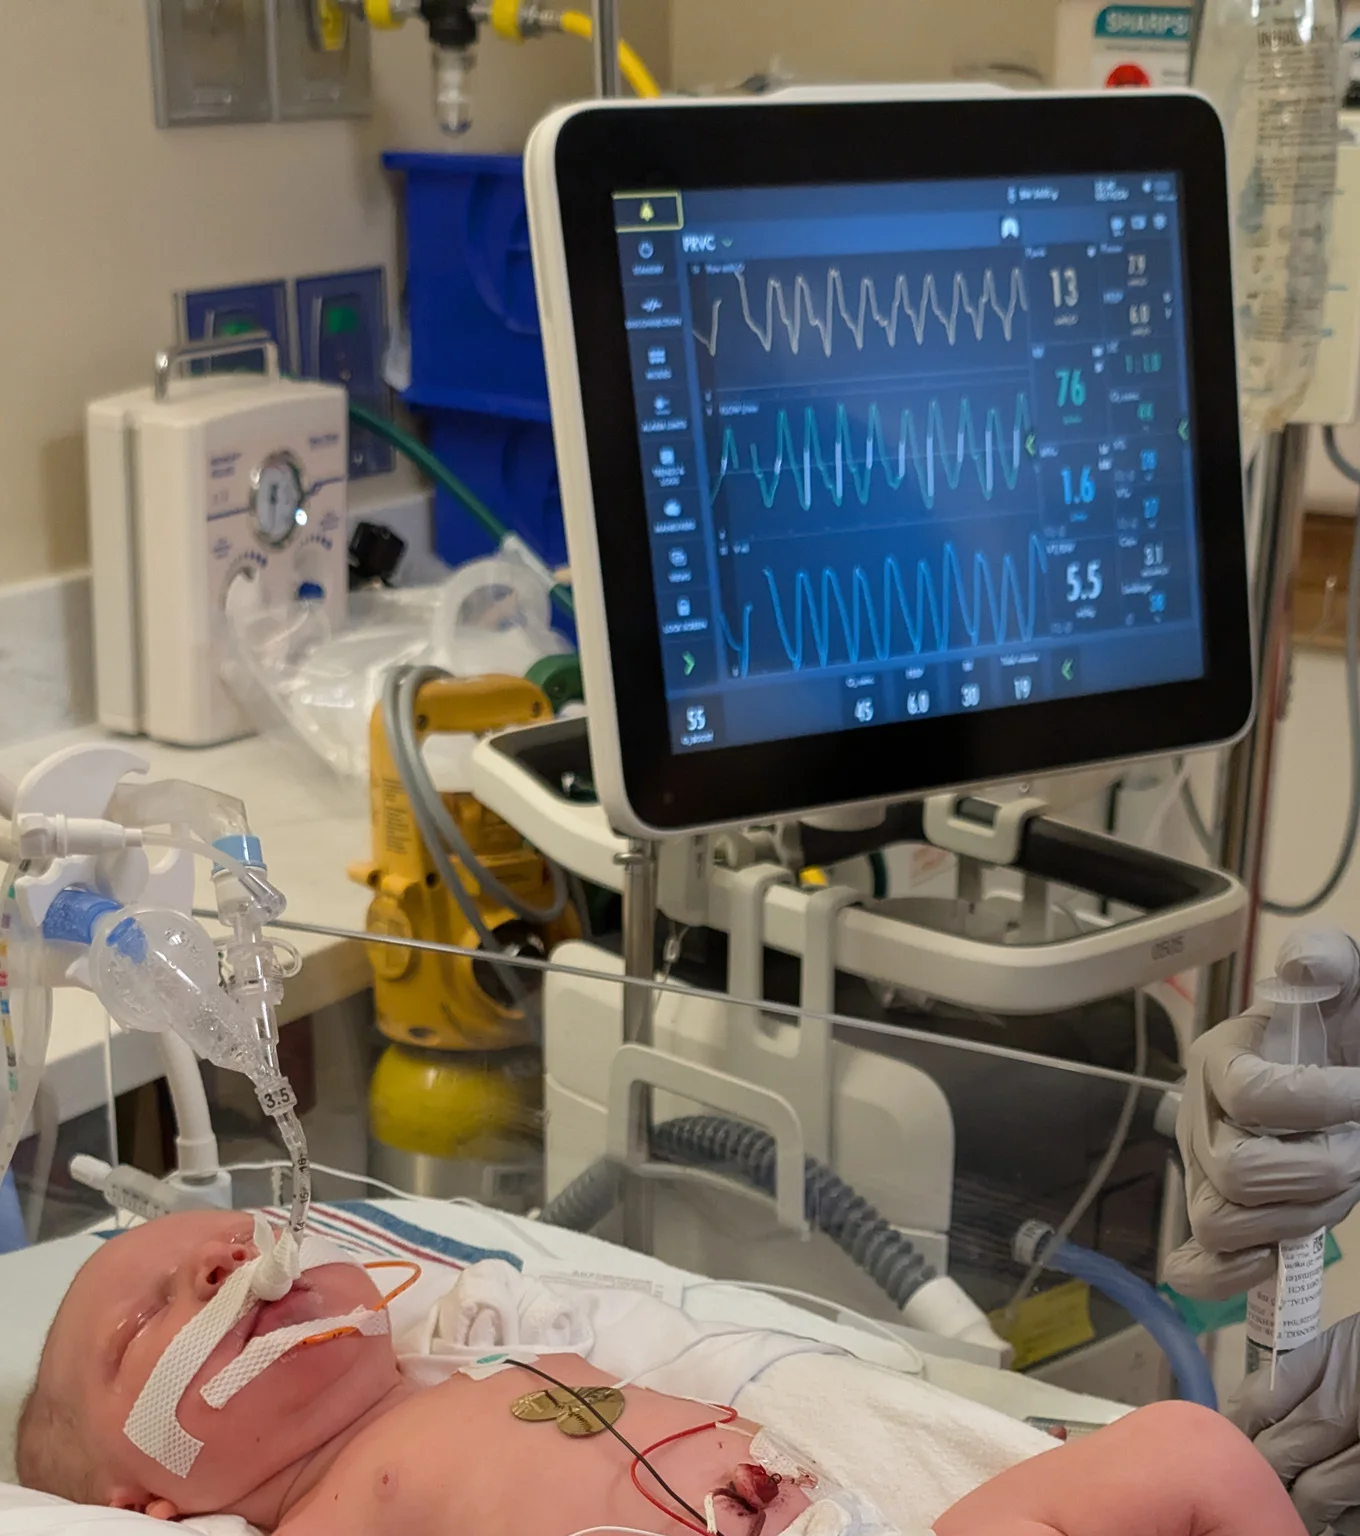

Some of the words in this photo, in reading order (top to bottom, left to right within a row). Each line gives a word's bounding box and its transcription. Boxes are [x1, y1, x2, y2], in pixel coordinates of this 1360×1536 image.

[681, 233, 717, 253] PRVC
[1049, 266, 1079, 308] 13
[1055, 368, 1086, 408] 76
[1060, 464, 1096, 505] 1.6
[1066, 559, 1104, 602] 5.5
[906, 689, 930, 715] 6.0
[960, 682, 981, 708] 30
[686, 705, 707, 730] 55
[263, 1086, 291, 1109] 3.5
